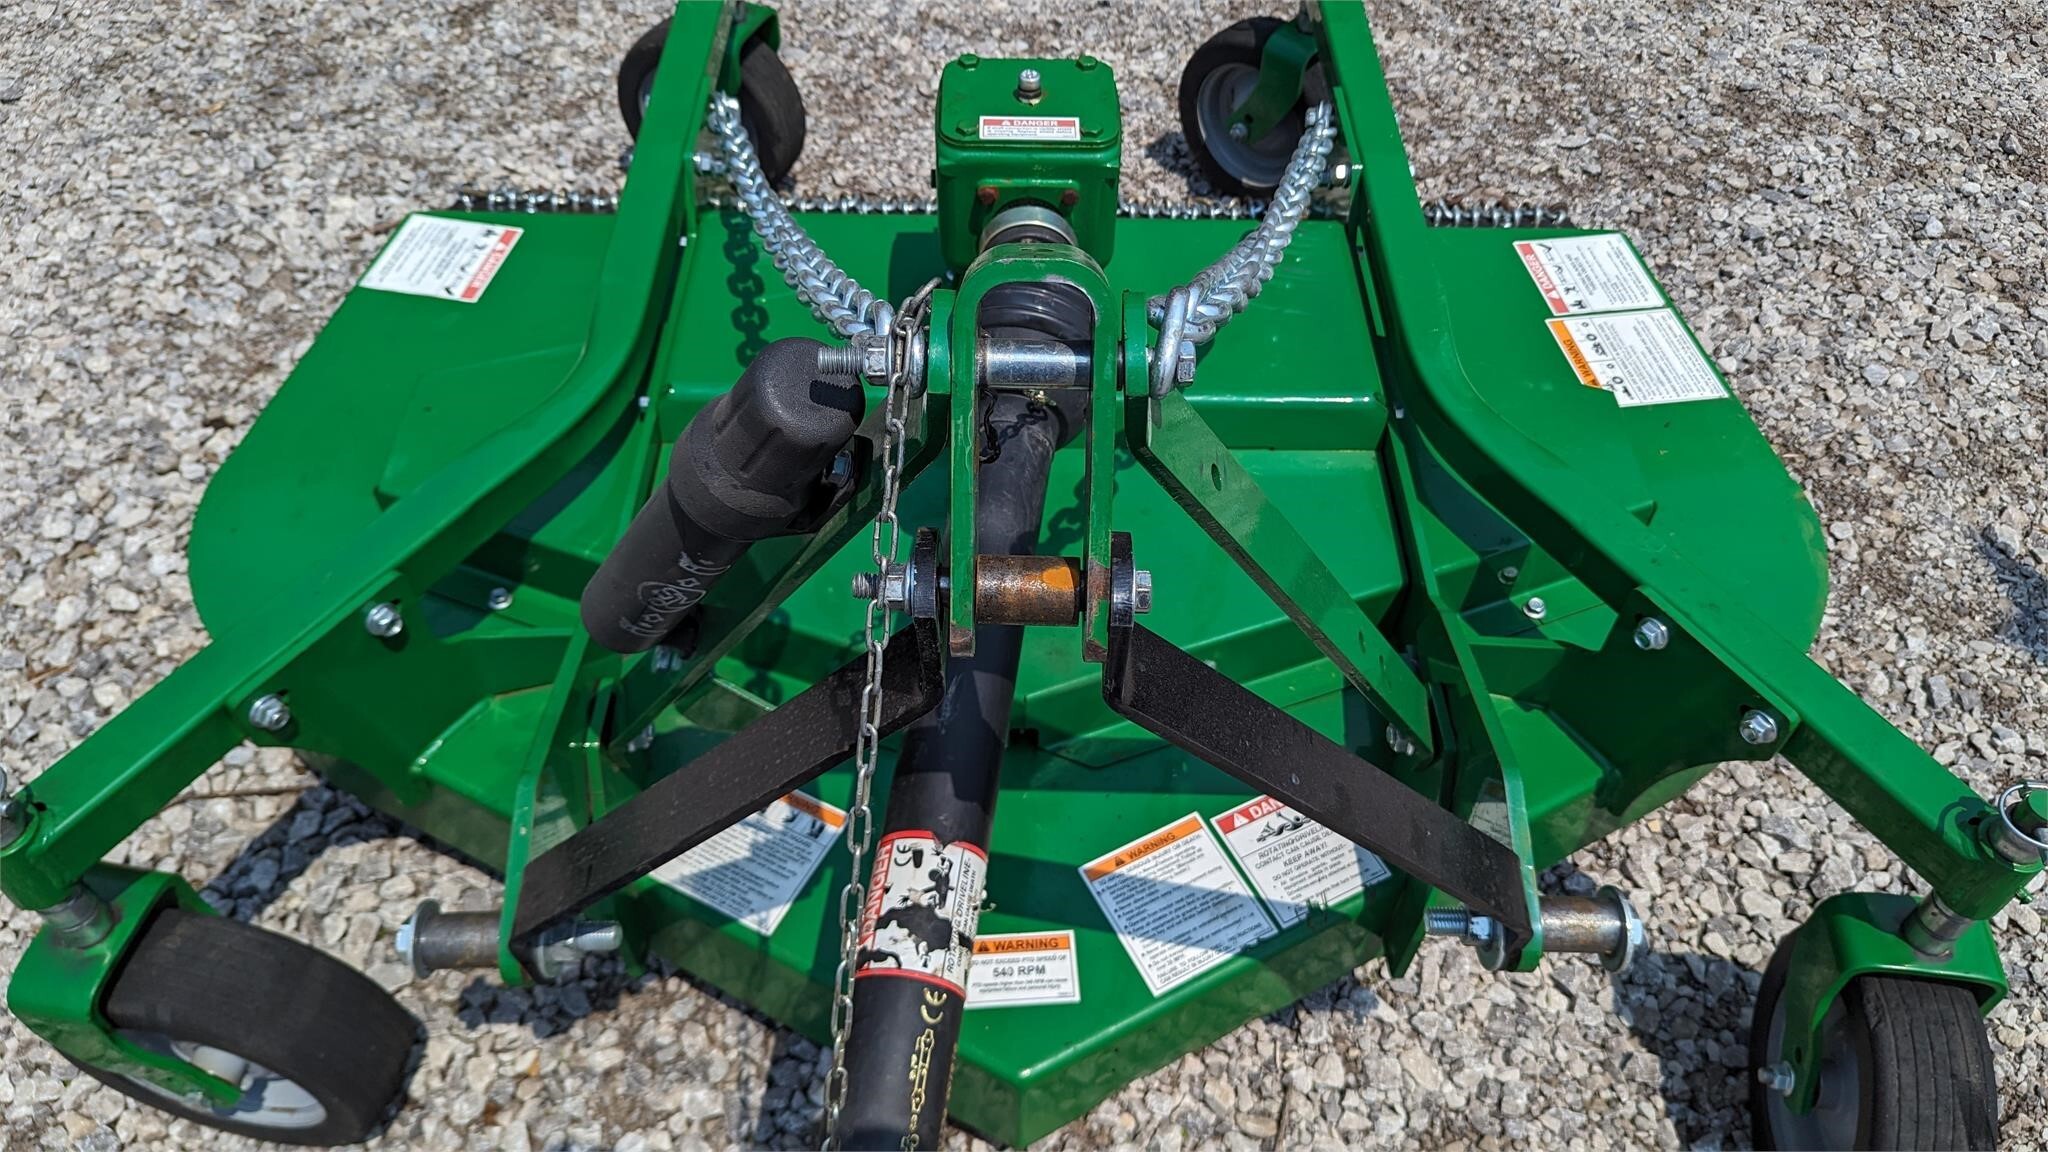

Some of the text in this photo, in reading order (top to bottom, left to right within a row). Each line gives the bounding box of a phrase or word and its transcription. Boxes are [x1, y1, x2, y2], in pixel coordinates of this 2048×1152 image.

[1524, 253, 1554, 289] DANGER
[1562, 339, 1592, 376] WARNING
[1249, 800, 1283, 819] DAN
[1125, 831, 1176, 860] WARNING
[1253, 851, 1284, 870] CONTACT
[1284, 844, 1300, 855] CAN
[1298, 833, 1321, 848] CAUSE
[1281, 853, 1304, 867] KEEP
[1301, 840, 1329, 857] AWAY!
[1271, 873, 1282, 881] DO
[1280, 867, 1294, 877] NOT
[861, 843, 892, 936] DANGER
[994, 938, 1058, 950] WARNING
[993, 965, 1045, 977] 540 RPM
[920, 988, 947, 1024] CE
